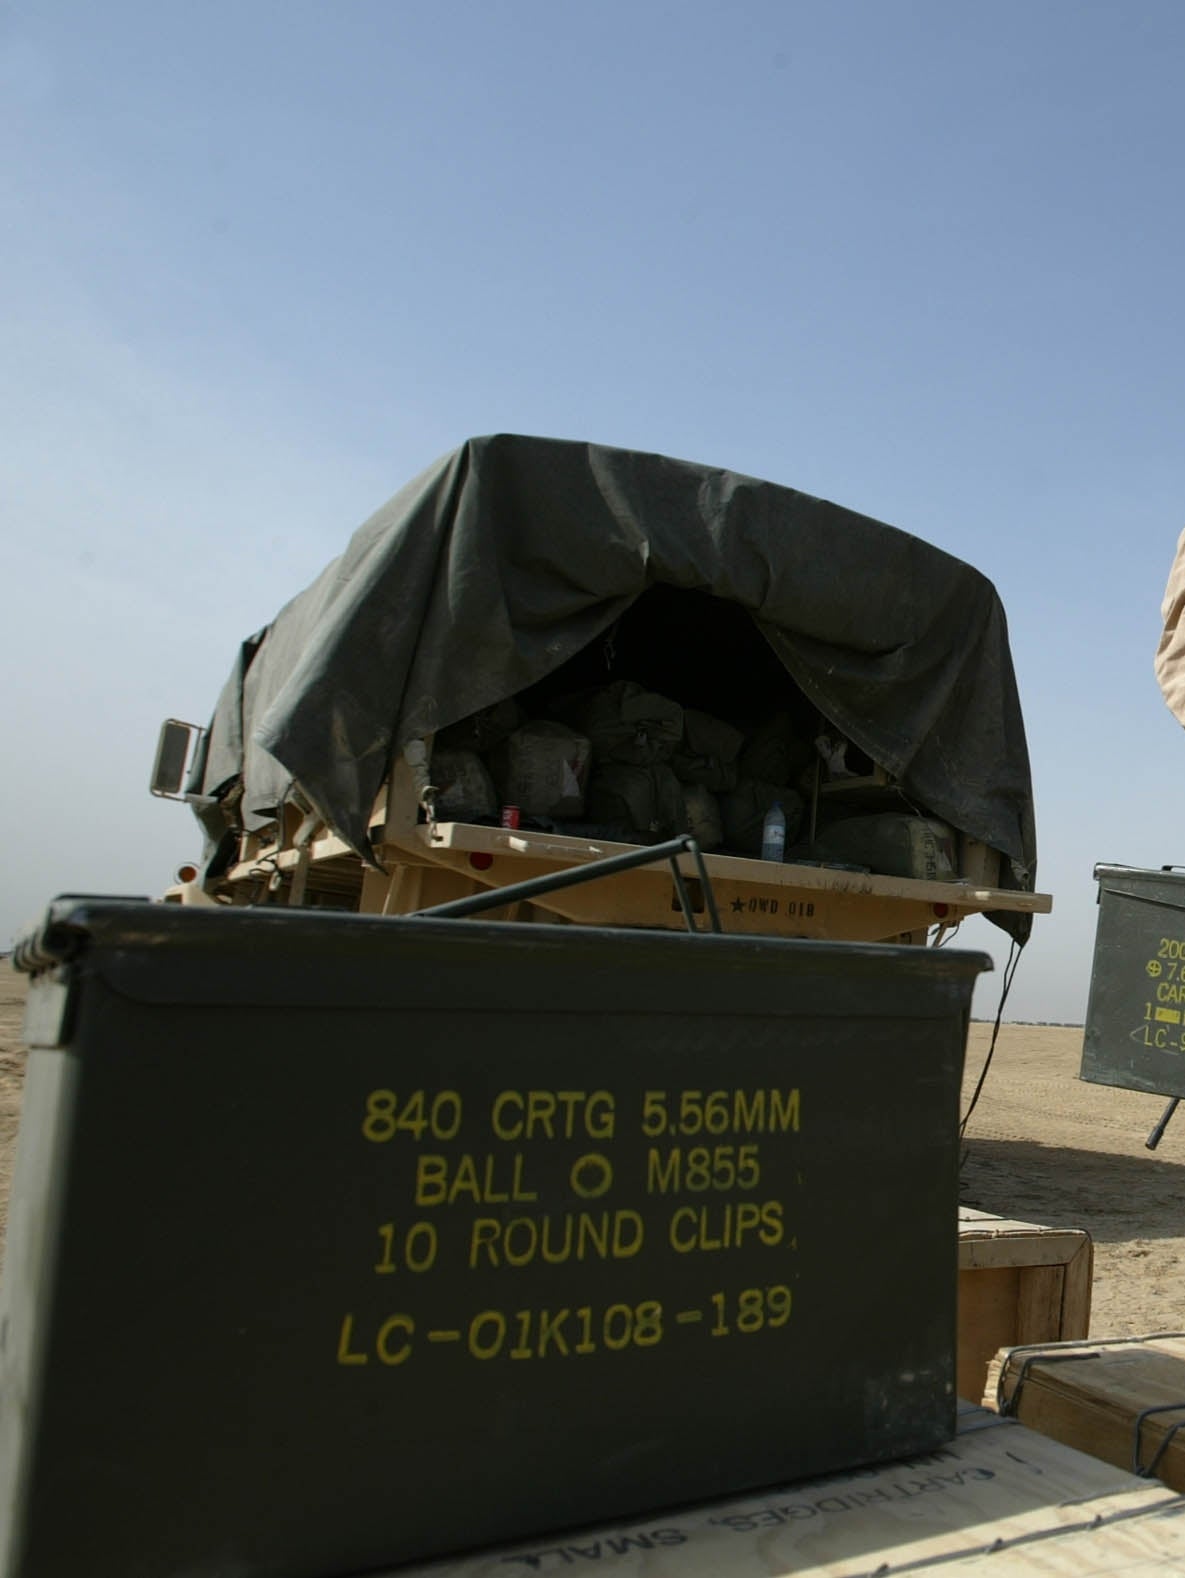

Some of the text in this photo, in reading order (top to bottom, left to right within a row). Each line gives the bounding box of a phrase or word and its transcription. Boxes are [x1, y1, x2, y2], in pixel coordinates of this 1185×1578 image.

[1143, 1002, 1152, 1021] 1
[362, 1088, 801, 1143] 840 CRTG 5.56MM
[415, 1144, 760, 1206] BALL M855
[375, 1201, 784, 1274] 10 ROUND CLIPS
